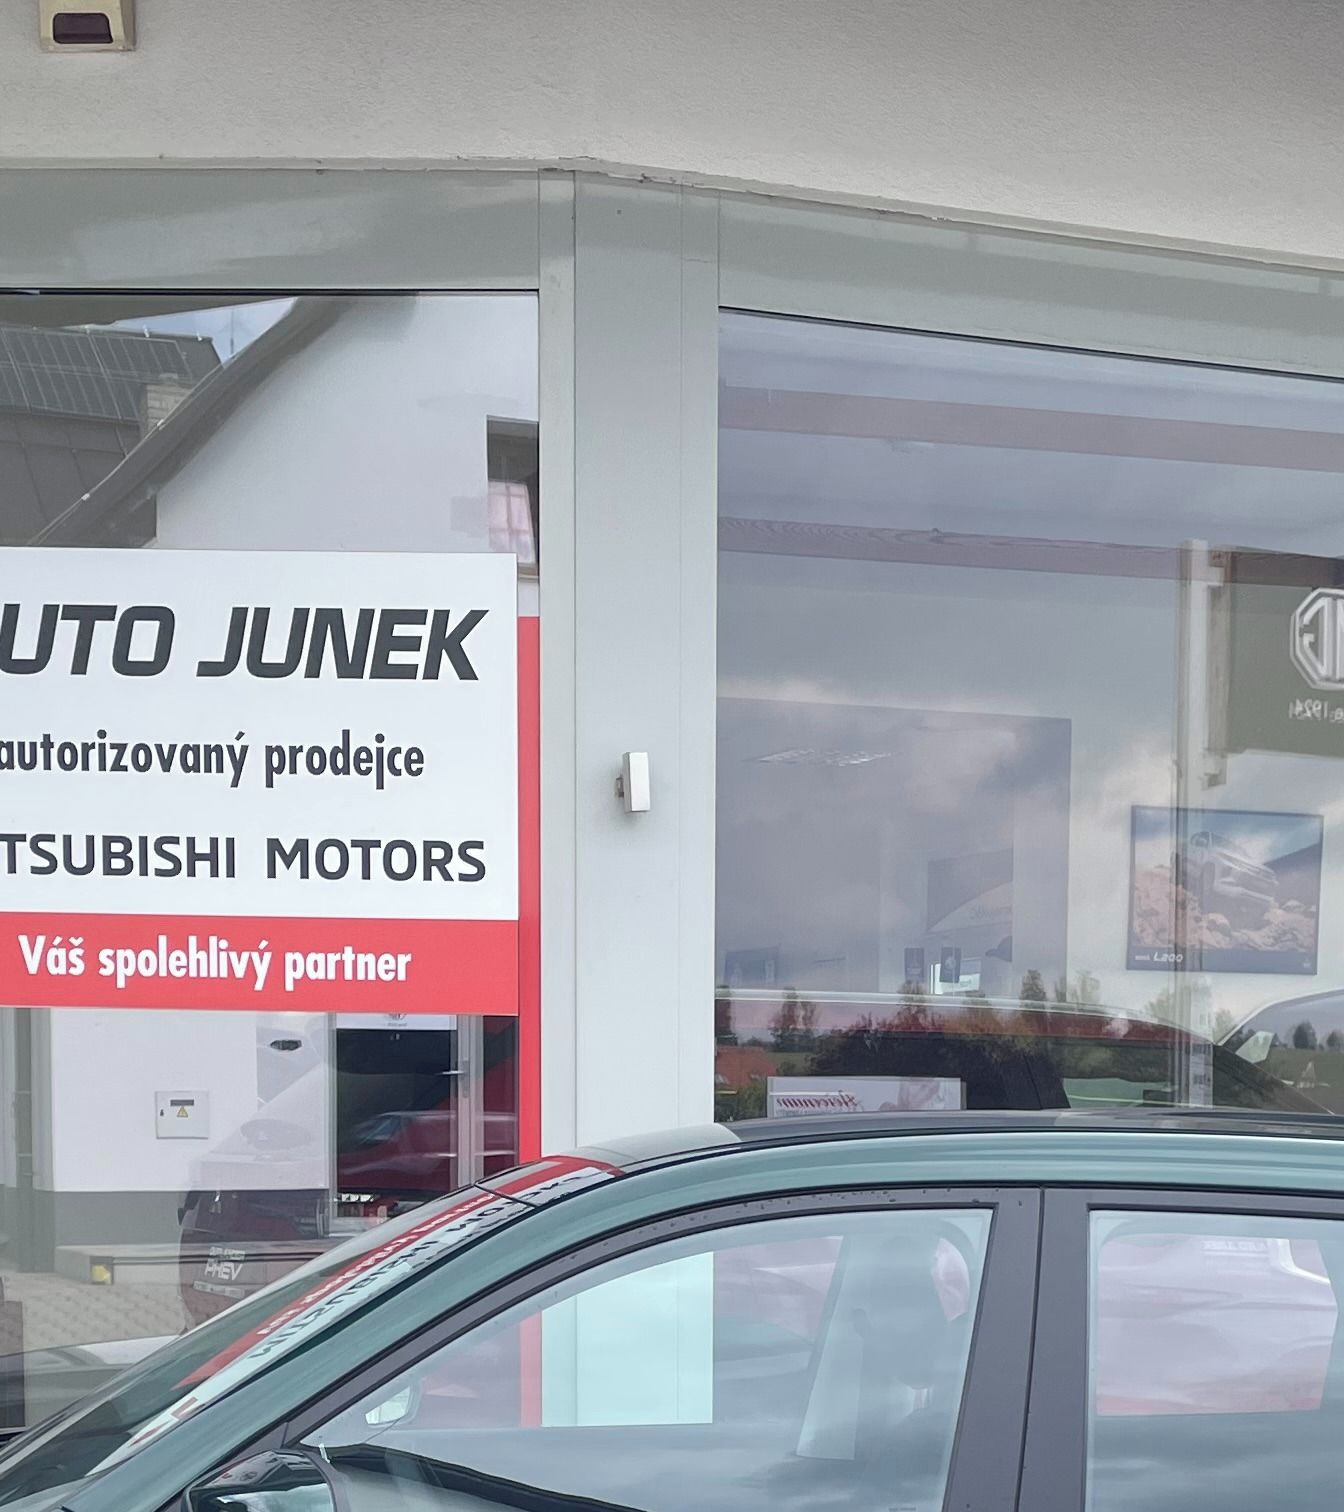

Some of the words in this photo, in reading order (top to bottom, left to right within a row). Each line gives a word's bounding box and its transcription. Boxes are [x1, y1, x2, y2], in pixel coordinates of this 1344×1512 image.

[196, 606, 489, 682] JUNEK
[264, 729, 425, 790] prodejce
[266, 837, 487, 883] MOTORS
[17, 934, 86, 976] Váš
[97, 934, 273, 991] spolehlivý
[284, 945, 413, 992] partner
